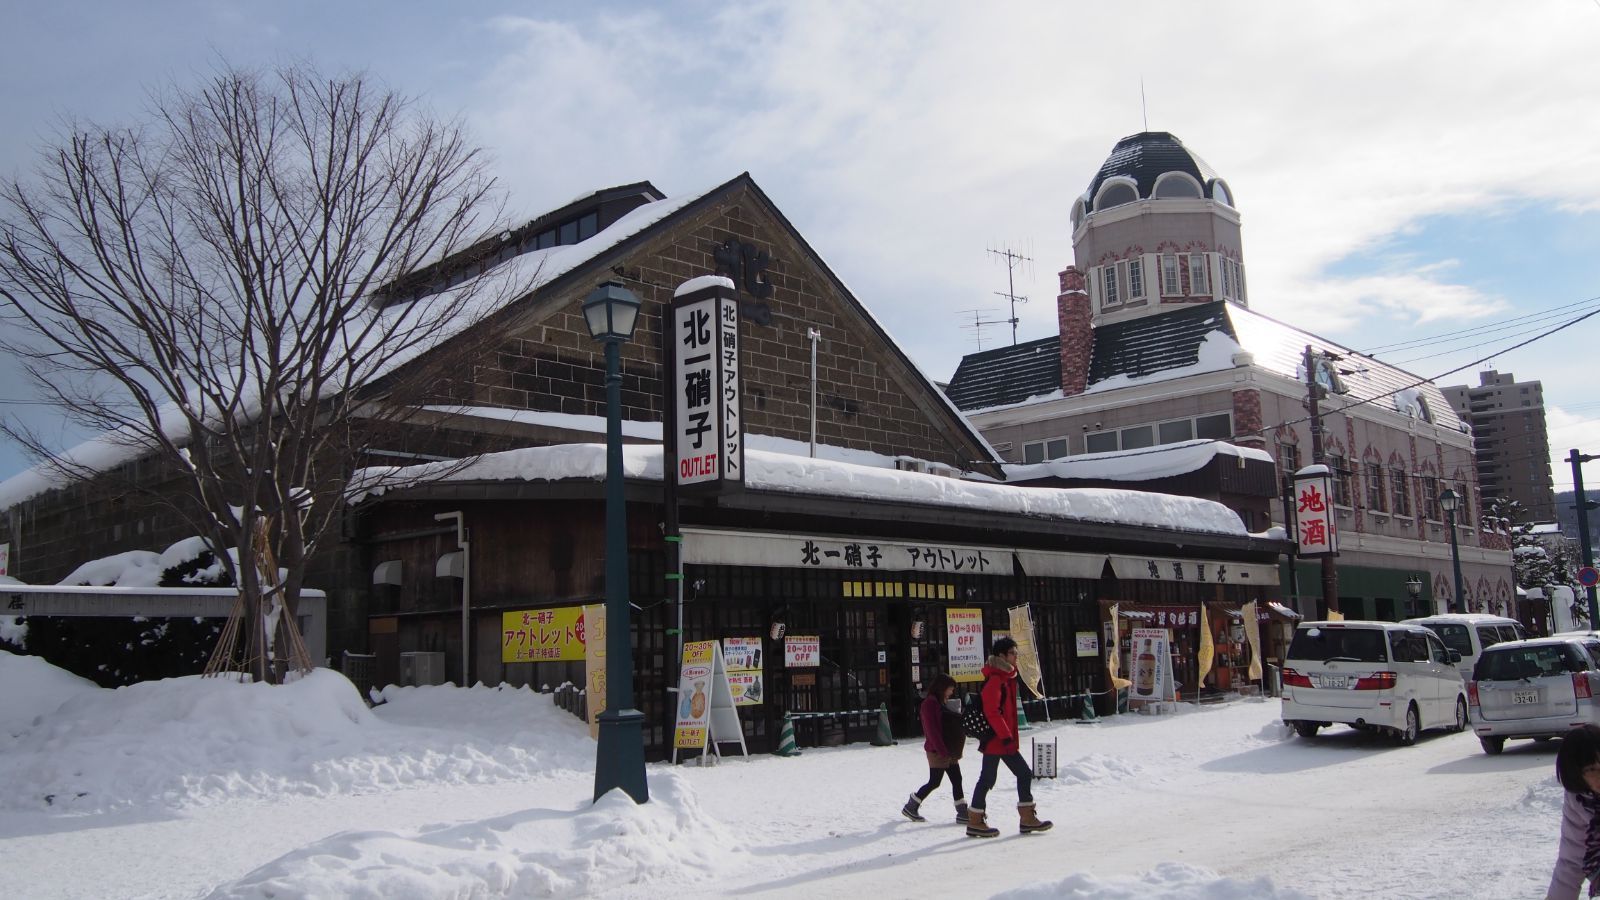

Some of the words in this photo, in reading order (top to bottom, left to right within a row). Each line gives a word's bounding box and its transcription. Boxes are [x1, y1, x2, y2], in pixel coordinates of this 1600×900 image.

[683, 308, 712, 449] 北一硝子
[722, 304, 738, 473] 北一硝子アウトレット
[680, 453, 717, 478] OUTLET
[1297, 484, 1326, 546] 地酒
[801, 540, 883, 568] 北一硝子
[906, 547, 990, 572] アウトレット
[522, 611, 554, 625] 北一硝子
[504, 625, 574, 647] アウトレット
[684, 642, 713, 652] 20~30%
[957, 636, 974, 645] OFF
[794, 653, 811, 661] OFF
[678, 738, 701, 746] OUTLET
